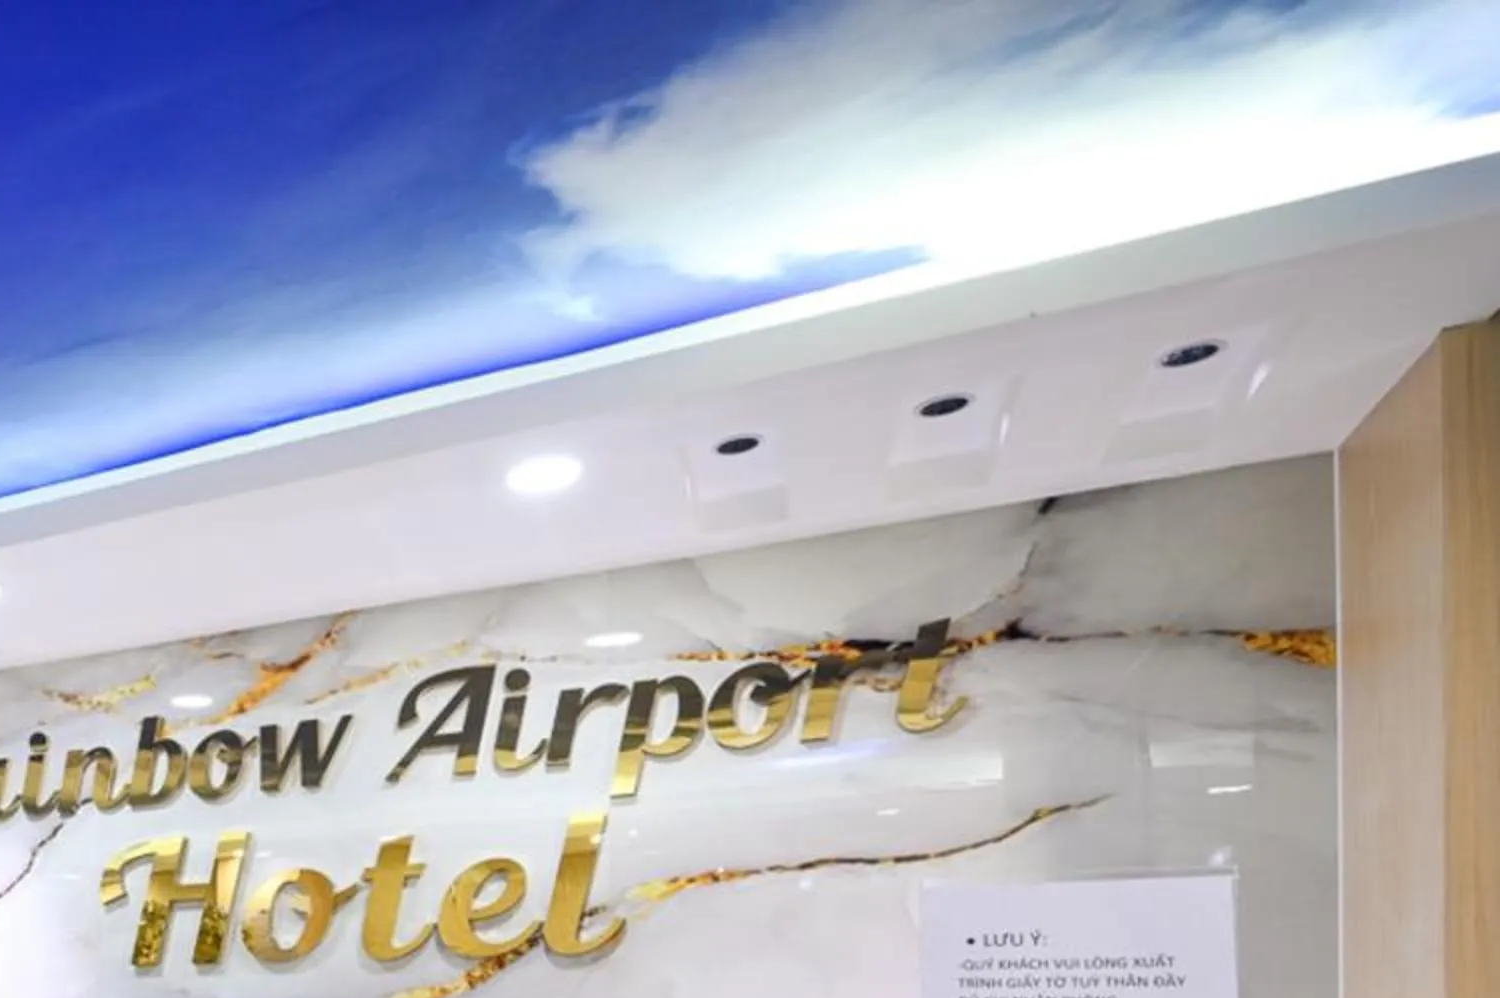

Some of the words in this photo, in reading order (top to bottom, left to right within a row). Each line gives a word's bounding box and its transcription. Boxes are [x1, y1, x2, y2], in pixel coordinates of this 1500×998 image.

[385, 618, 969, 799] Airport
[100, 812, 627, 970] Hotel
[982, 931, 1024, 947] LƯU
[1053, 958, 1080, 970] VUI
